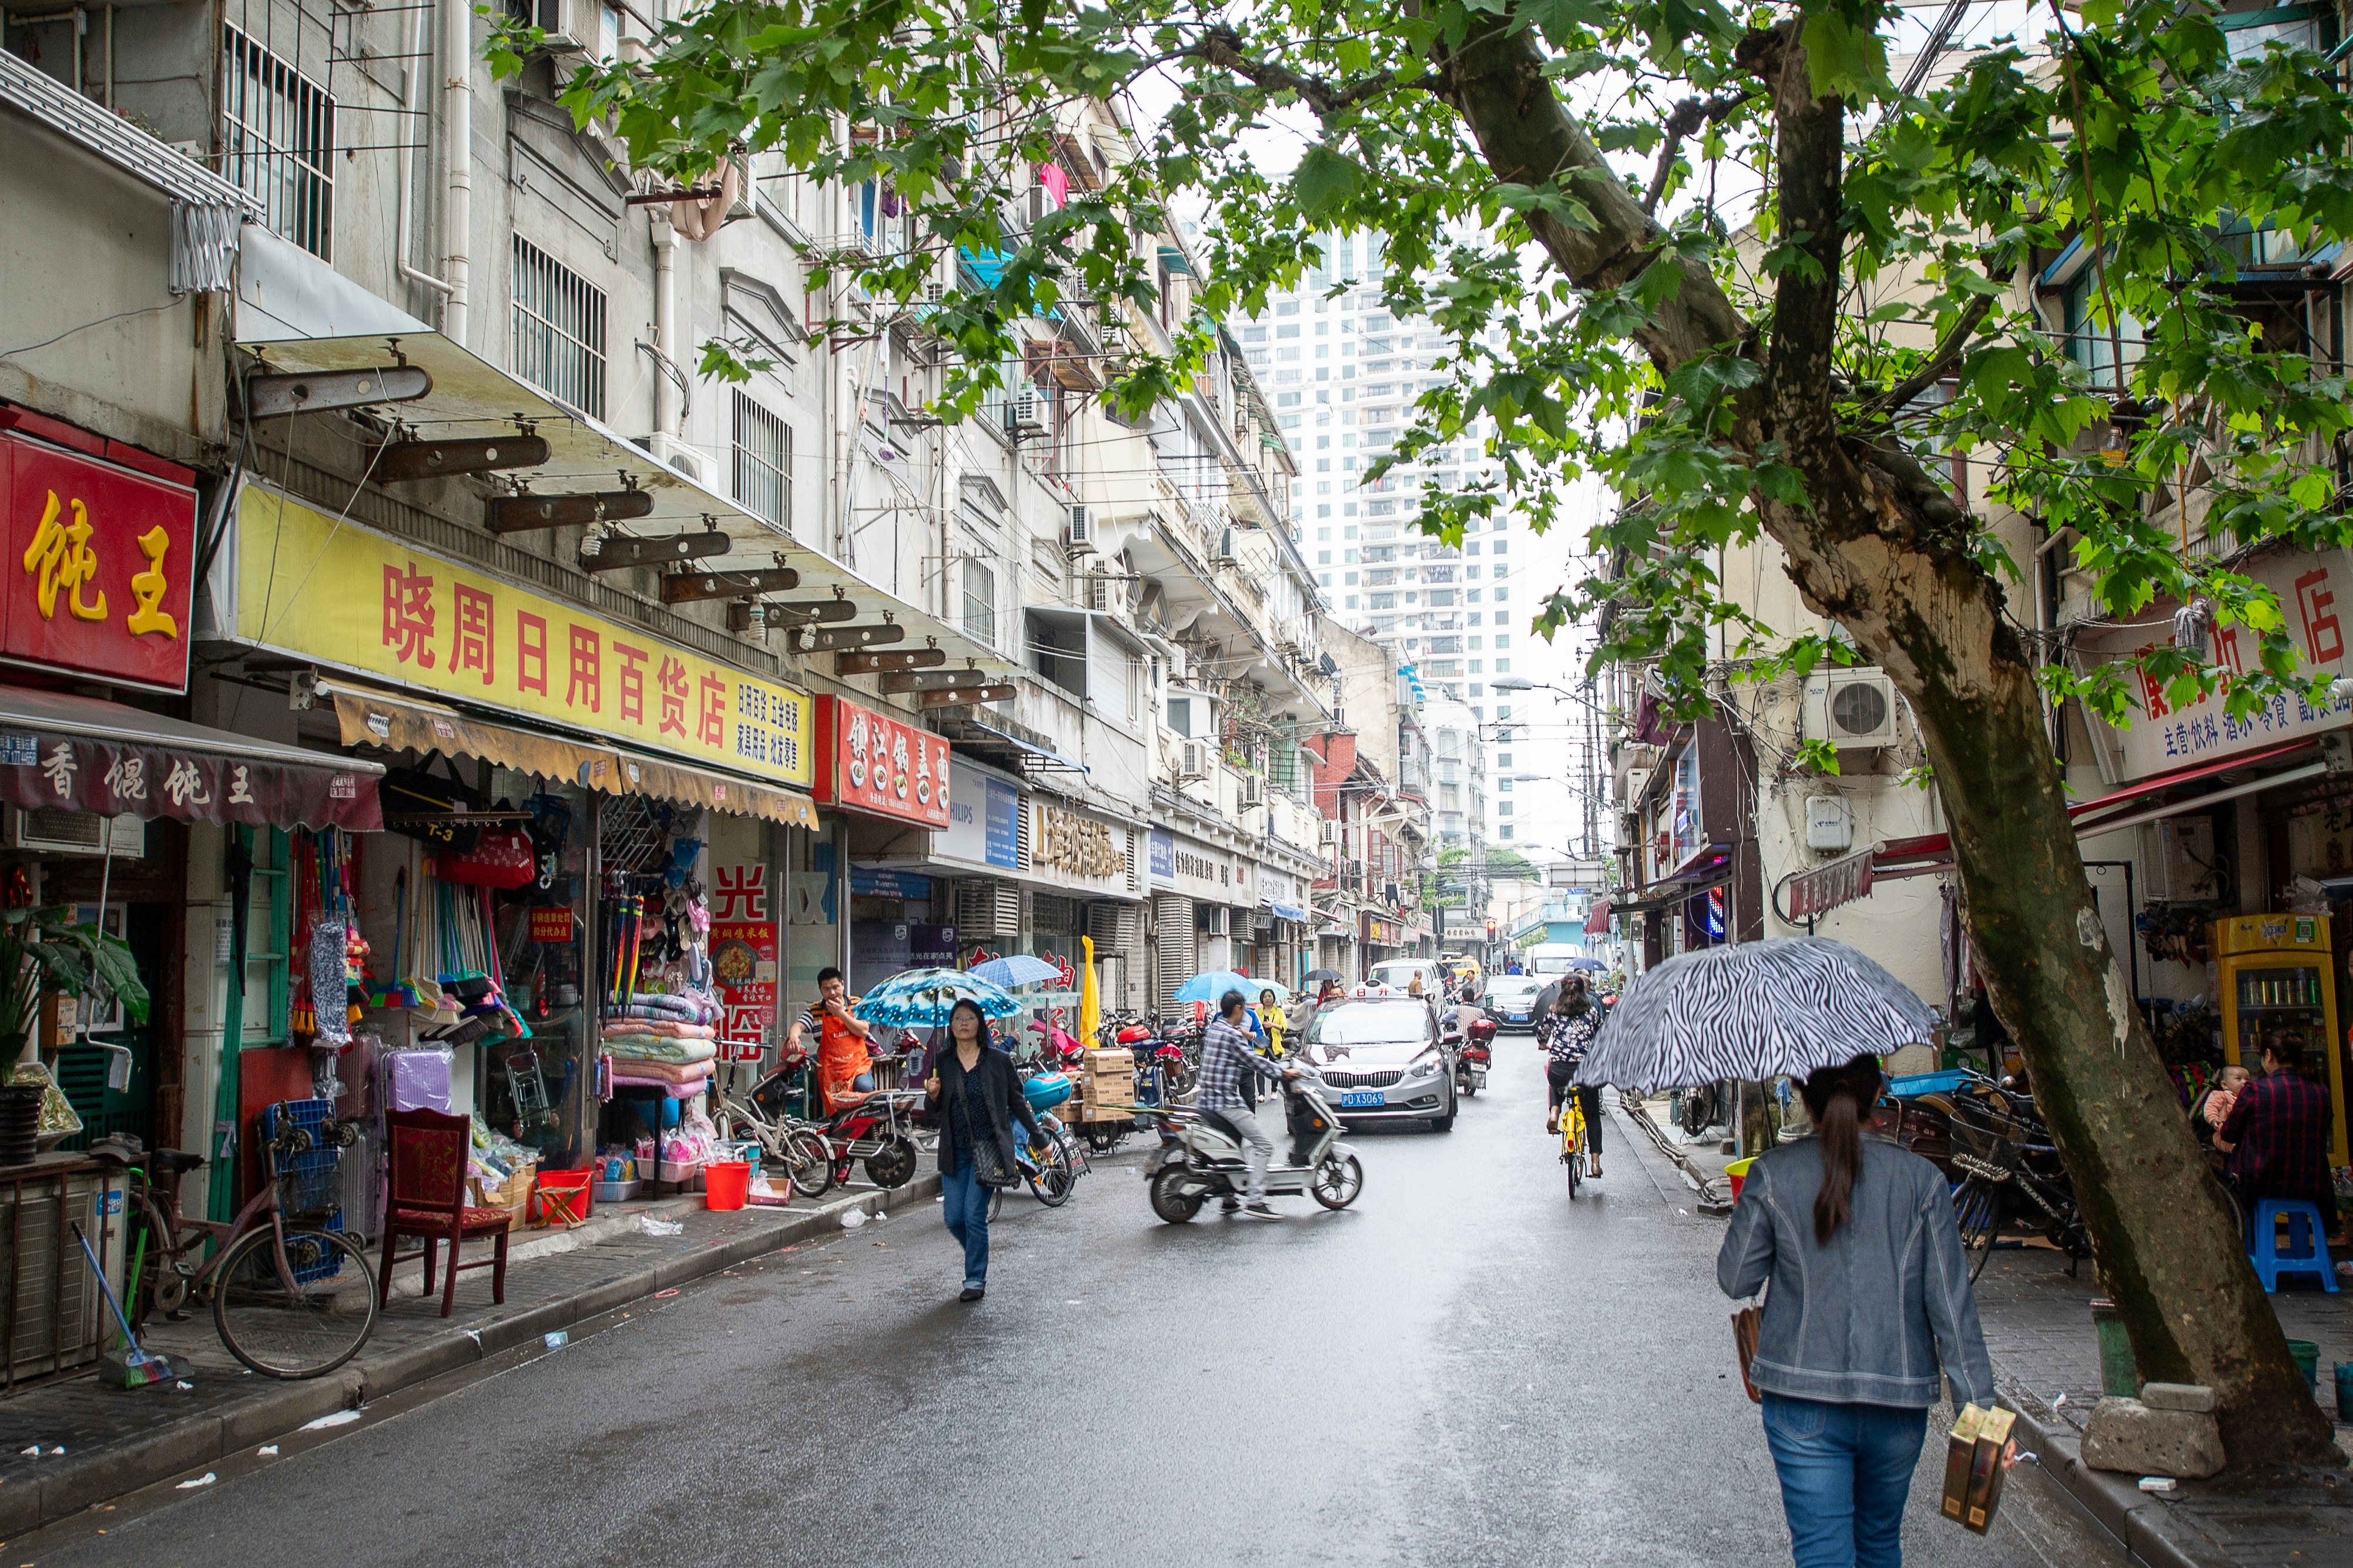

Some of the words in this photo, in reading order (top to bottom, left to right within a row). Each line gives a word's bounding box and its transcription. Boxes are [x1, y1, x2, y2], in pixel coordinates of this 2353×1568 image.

[24, 489, 177, 640] 饨王
[383, 562, 726, 748] 晓周日用百货店
[739, 684, 767, 723] 日用百货
[771, 695, 797, 733] 五金电器
[737, 721, 766, 762] 家具用品
[770, 732, 797, 771] 批发零售
[847, 713, 948, 786] 镇江锅盖面
[41, 741, 254, 806] 香馄饨王
[429, 824, 453, 841] T-3
[950, 801, 973, 824] HILIPS
[715, 865, 765, 919] 光
[534, 926, 567, 936] 扣分代办点
[710, 927, 769, 939] 黄焖鸡米饭
